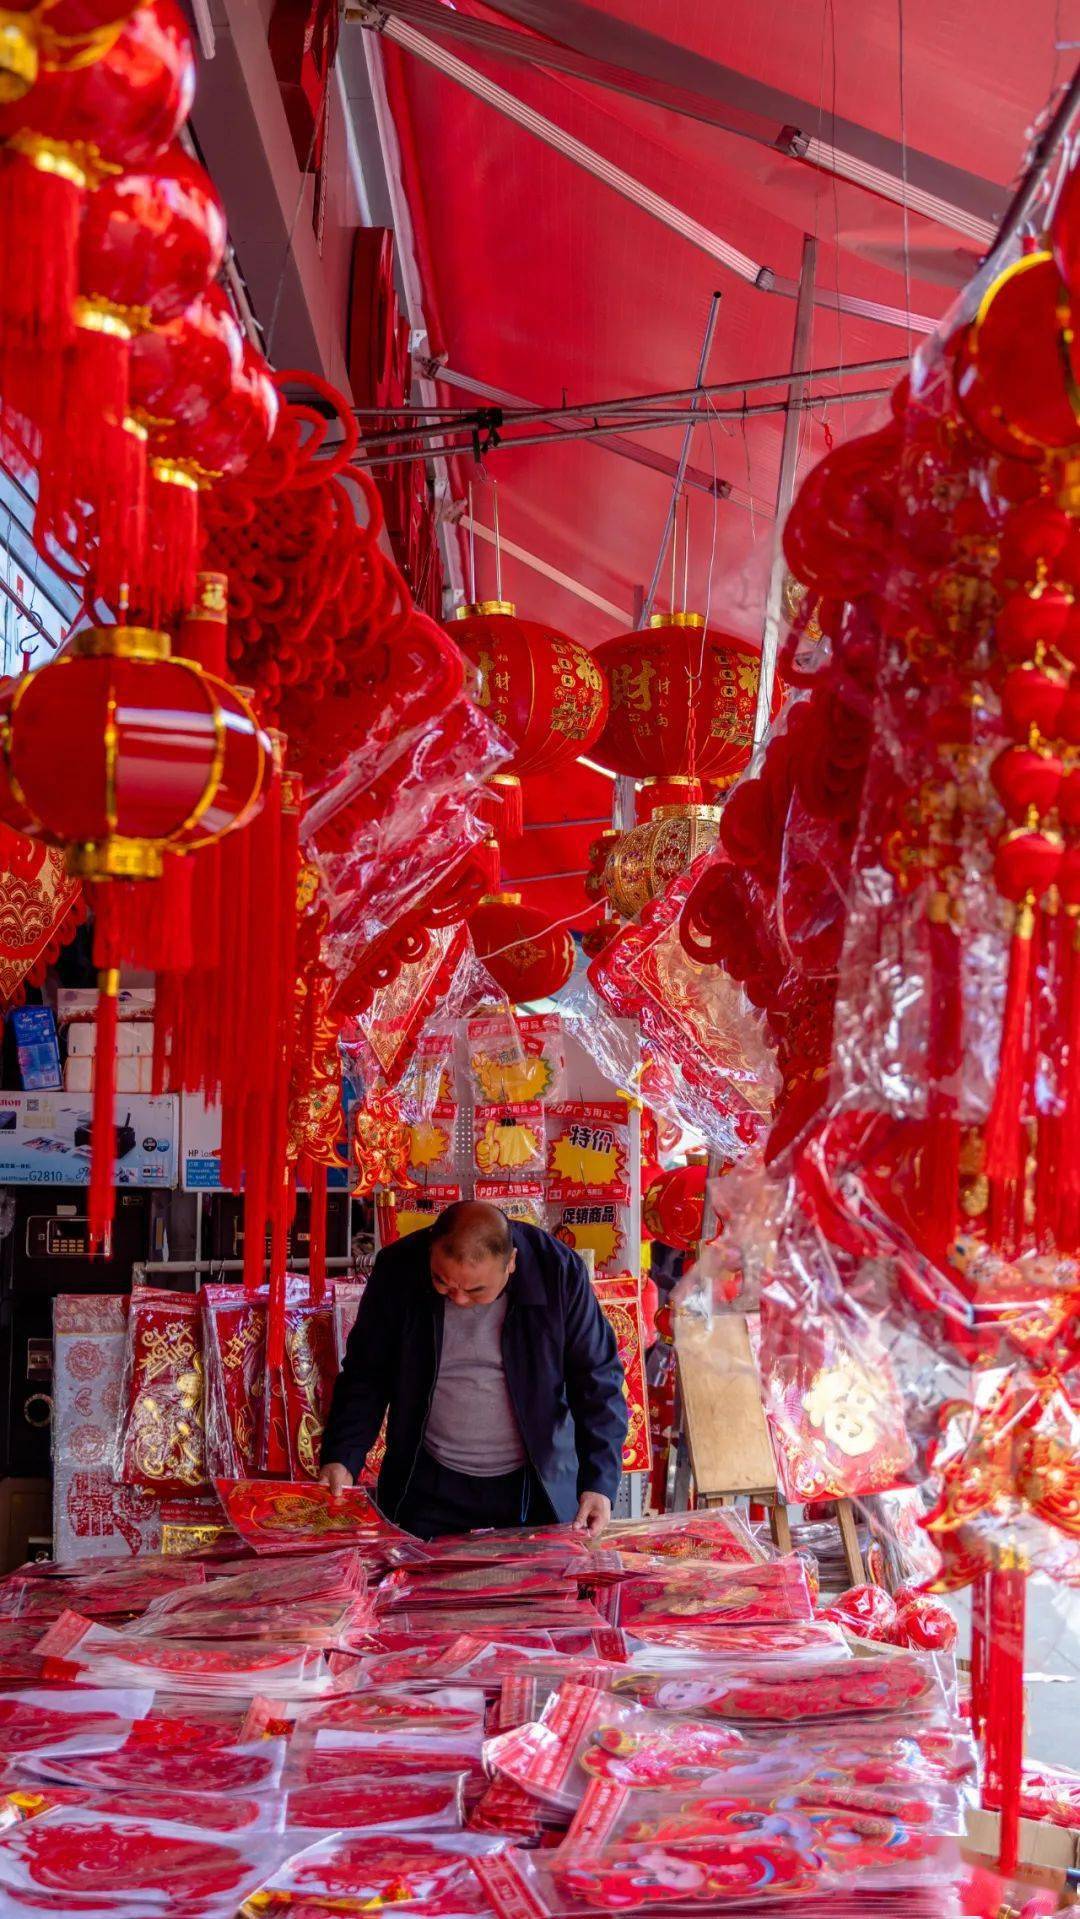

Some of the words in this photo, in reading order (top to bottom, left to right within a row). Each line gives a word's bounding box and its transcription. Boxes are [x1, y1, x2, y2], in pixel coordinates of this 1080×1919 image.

[569, 1125, 613, 1154] 特价
[188, 1149, 198, 1157] HP
[562, 1205, 614, 1224] 促销商品
